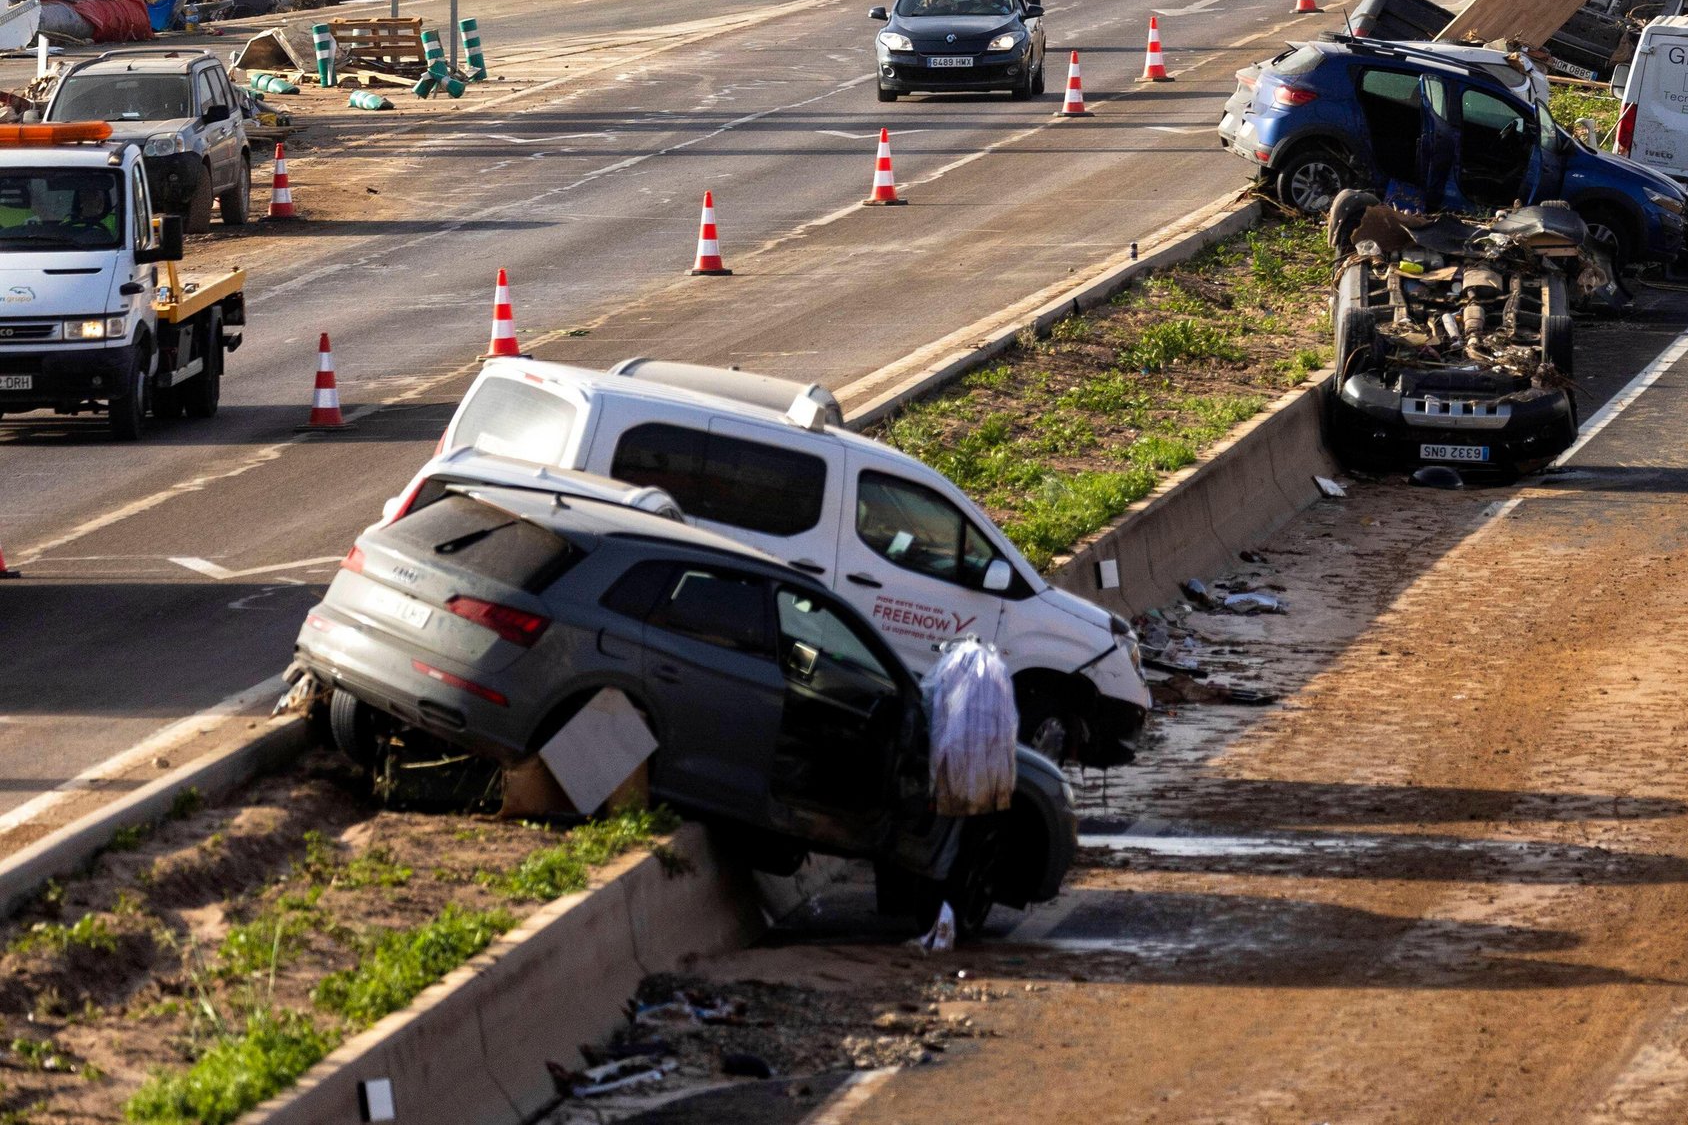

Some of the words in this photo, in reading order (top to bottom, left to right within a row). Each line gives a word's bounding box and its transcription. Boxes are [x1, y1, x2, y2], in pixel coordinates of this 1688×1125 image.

[1645, 150, 1673, 159] IVECO
[6, 378, 30, 388] DRH
[1424, 446, 1446, 457] GNS
[1451, 447, 1481, 458] 6332
[873, 604, 950, 632] FREENOW
